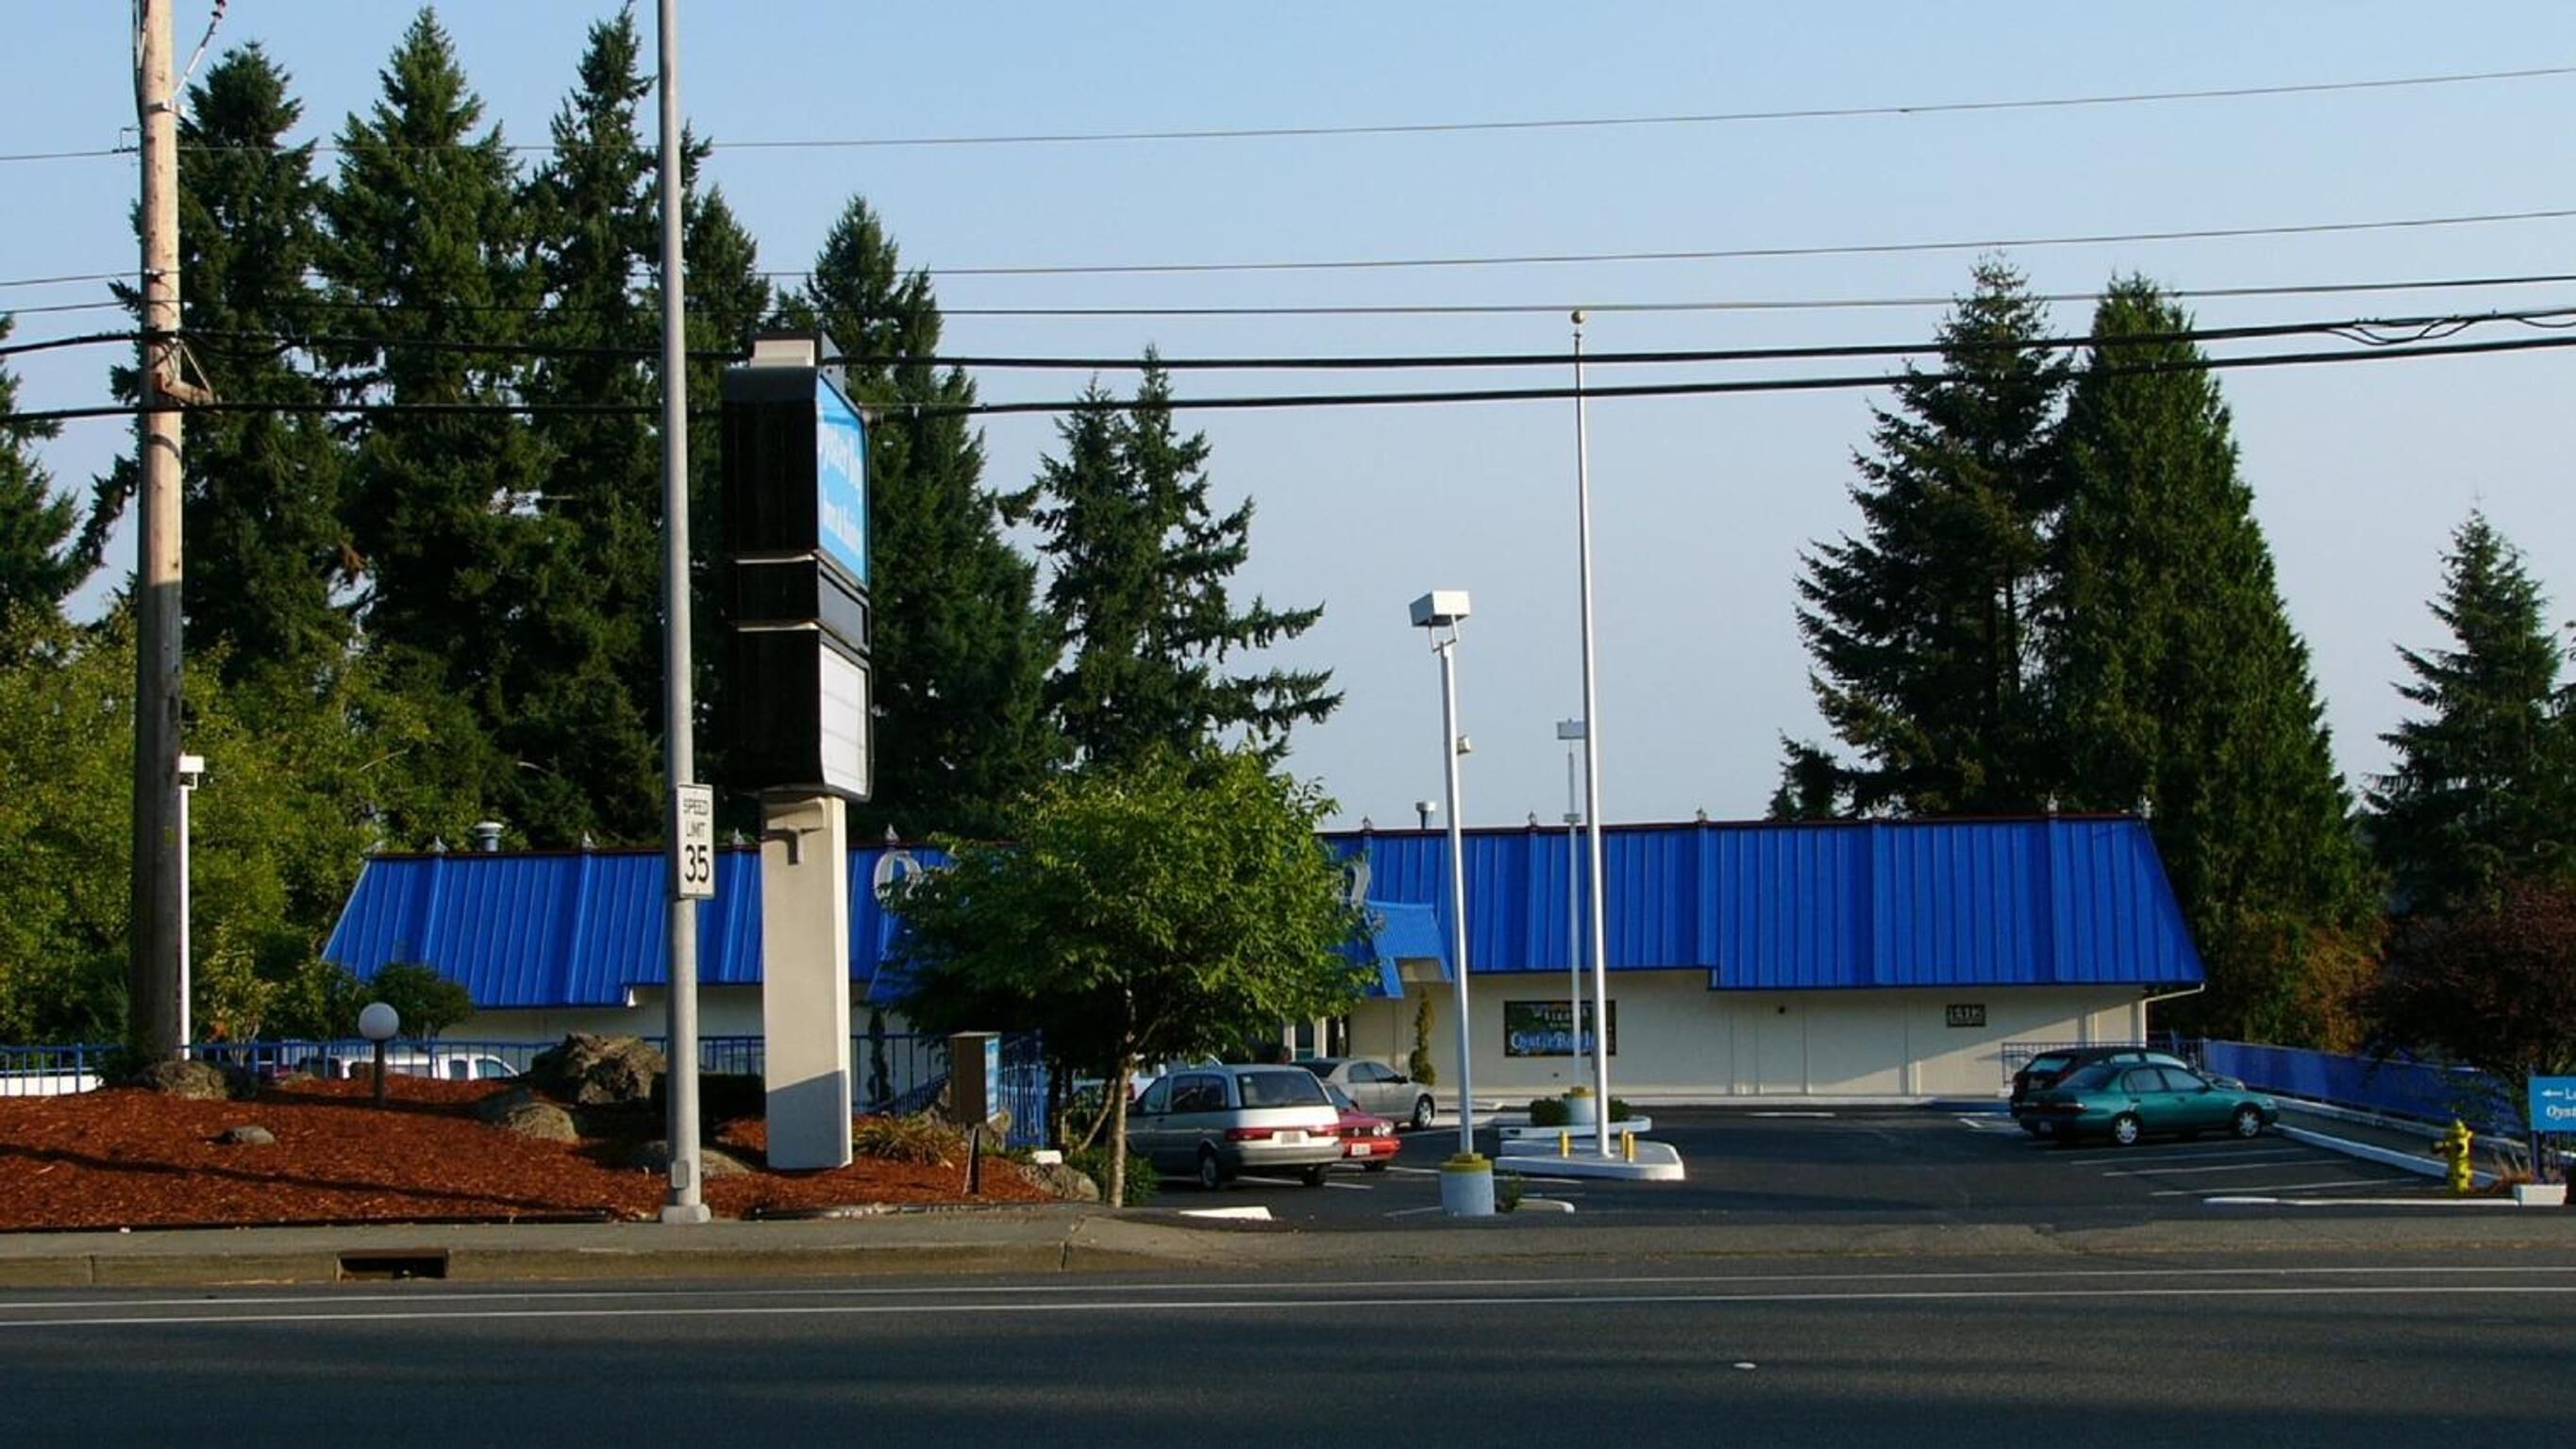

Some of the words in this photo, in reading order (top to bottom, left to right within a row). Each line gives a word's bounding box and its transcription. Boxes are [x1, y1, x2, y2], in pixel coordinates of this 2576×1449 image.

[683, 798, 709, 816] SPEED
[686, 820, 706, 838] LIMIT
[685, 844, 710, 883] 35
